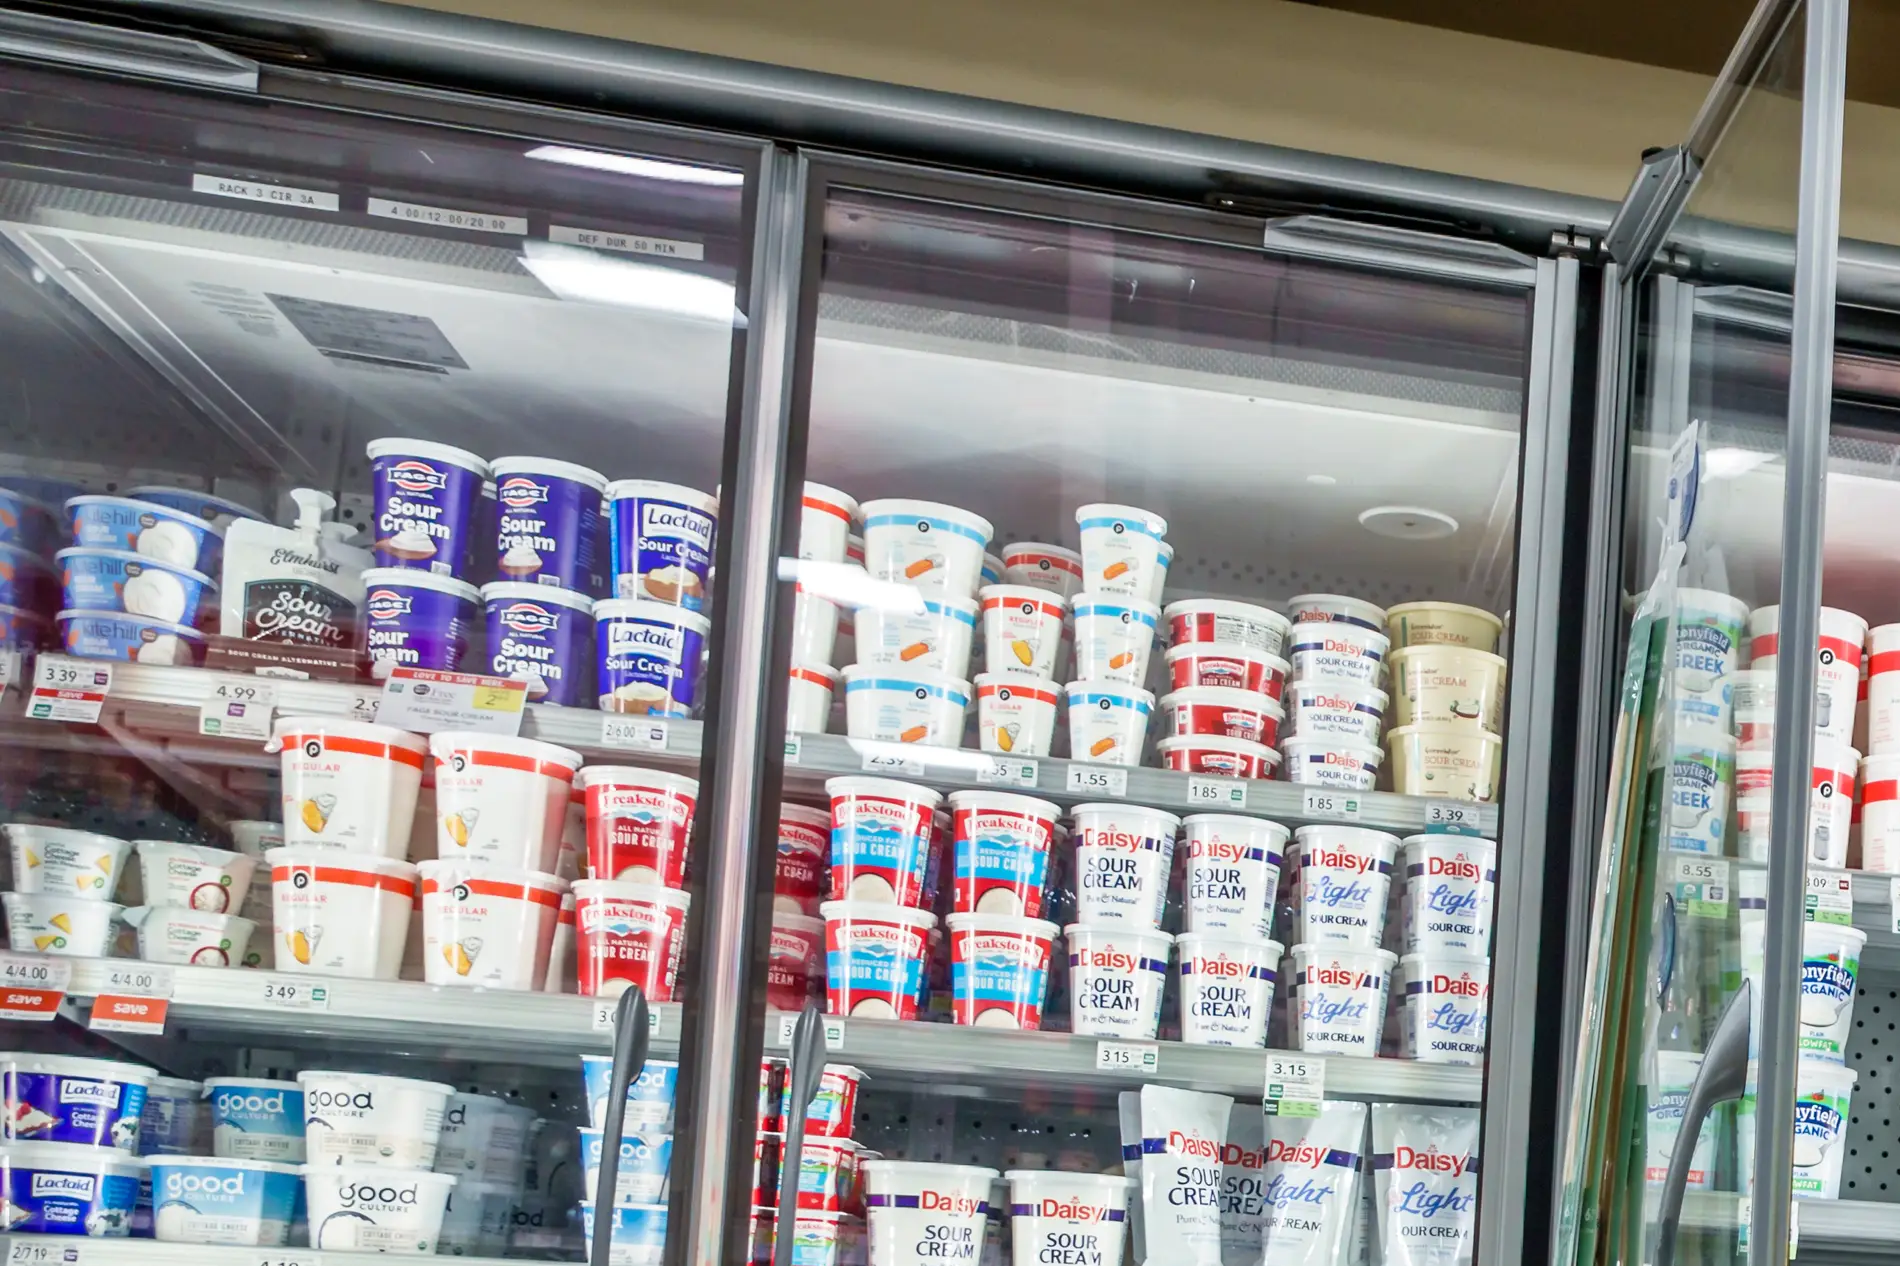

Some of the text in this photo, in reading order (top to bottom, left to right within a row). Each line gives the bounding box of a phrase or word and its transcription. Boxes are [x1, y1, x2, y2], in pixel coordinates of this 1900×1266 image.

[219, 183, 247, 196] RACK
[256, 188, 262, 197] 3
[655, 243, 675, 253] MIN
[388, 497, 442, 520] Sour
[380, 514, 451, 540] Cream
[500, 516, 546, 534] Sour
[648, 506, 710, 536] Lactaid
[639, 538, 673, 554] Sour
[269, 549, 340, 576] Elmhurst
[271, 592, 332, 623] Sour
[255, 608, 344, 643] Cream
[501, 638, 554, 658] Sour
[1323, 638, 1364, 658] Daisy
[493, 655, 562, 680] Cream
[606, 657, 683, 679] Sour Cream
[412, 671, 436, 681] LOVE
[455, 675, 478, 685] SAVE
[57, 689, 84, 701] save
[216, 685, 256, 701] 4.99
[1315, 695, 1357, 714] Daisy
[1073, 772, 1108, 786] 1.55
[1431, 807, 1464, 822] 3.39
[1088, 857, 1137, 874] SOUR
[1682, 865, 1712, 877] 8.55
[1083, 873, 1143, 891] CREAM
[1194, 868, 1241, 885] SOUR
[1307, 876, 1372, 903] Light
[110, 974, 152, 988] 4/4.00
[8, 993, 42, 1007] save
[1198, 985, 1247, 1003] SOUR
[113, 1001, 149, 1016] save
[1078, 995, 1140, 1012] CREAM
[1191, 1002, 1251, 1021] CREAM
[1302, 992, 1368, 1024] Light
[1331, 1032, 1365, 1045] CREAM
[1273, 1062, 1306, 1077] 3.15
[217, 1090, 285, 1117] good
[308, 1088, 374, 1115] good
[1269, 1139, 1330, 1169] Daisy
[1396, 1146, 1469, 1177] Daisy
[34, 1175, 91, 1193] Lactaid
[165, 1170, 244, 1201] good
[1263, 1173, 1335, 1209] Light
[338, 1182, 418, 1208] good
[1394, 1181, 1474, 1217] Light
[43, 1204, 80, 1217] Cottage
[359, 1203, 410, 1213] CULTURE
[43, 1213, 78, 1223] Cheese
[1046, 1232, 1097, 1250] SOUR
